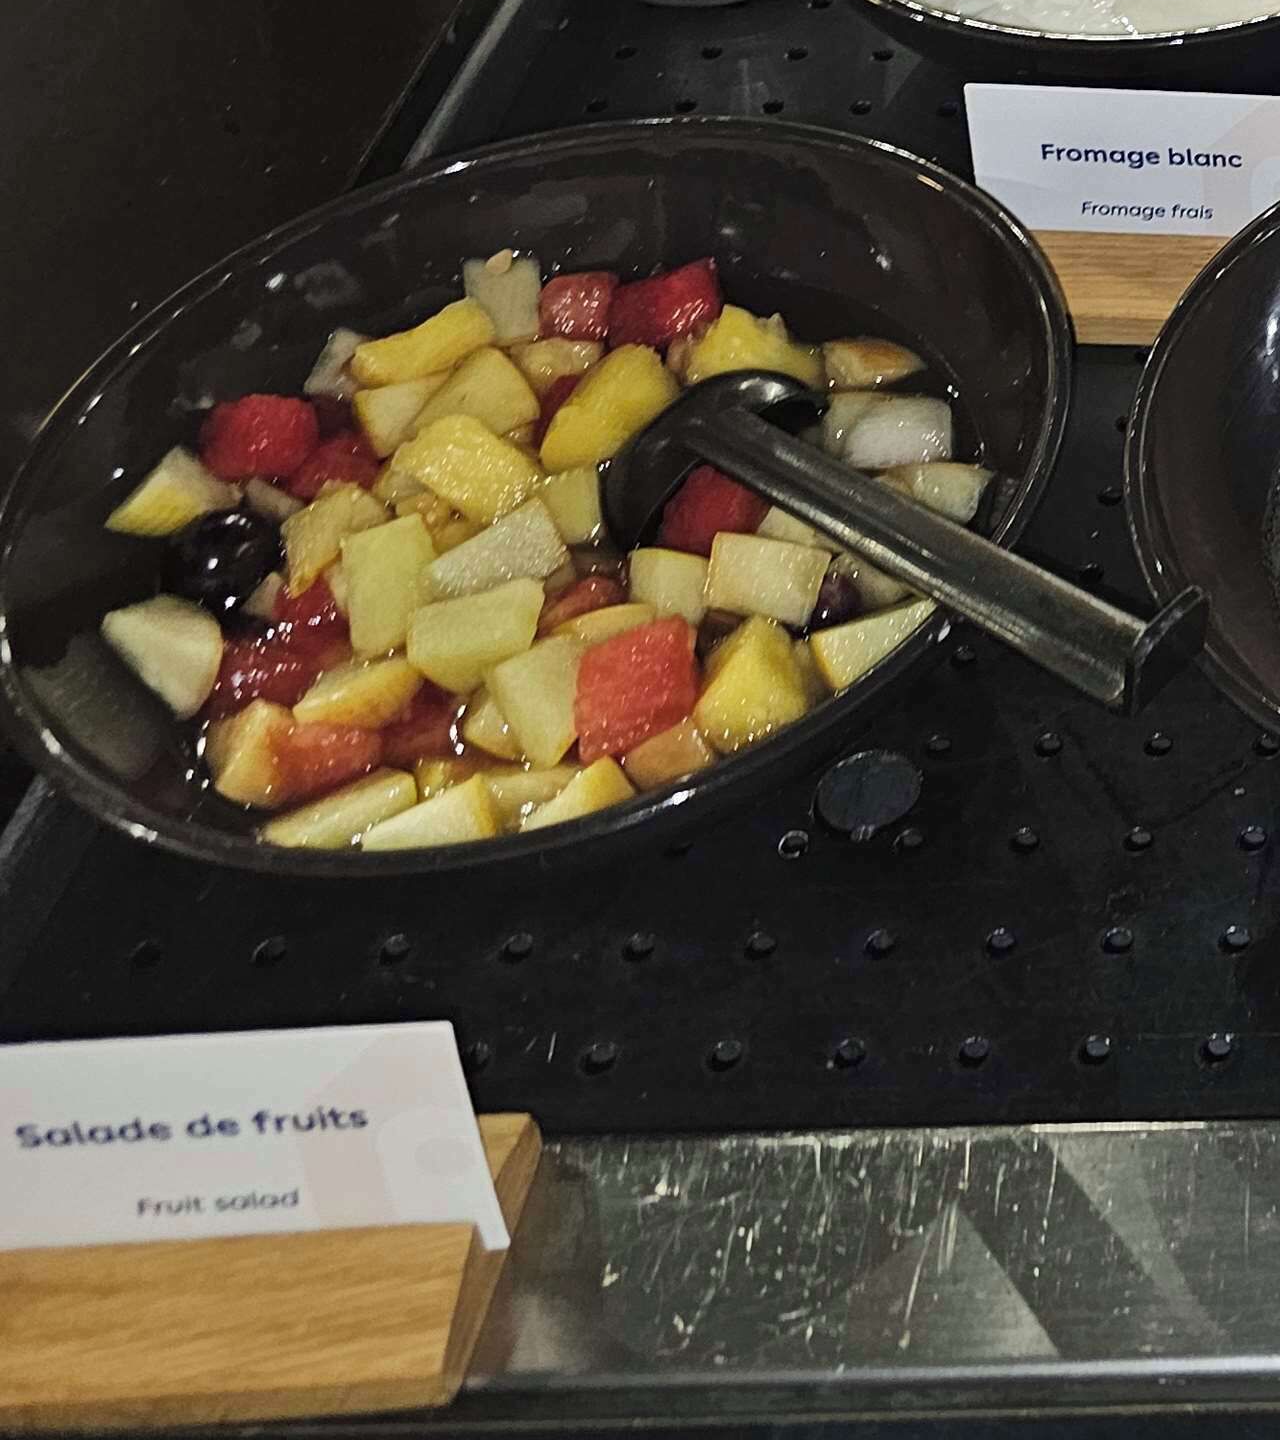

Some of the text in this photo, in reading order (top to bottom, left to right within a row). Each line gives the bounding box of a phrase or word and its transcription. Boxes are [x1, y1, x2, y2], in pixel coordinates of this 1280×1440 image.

[1040, 143, 1243, 170] Fromage blanc
[1080, 200, 1214, 221] Fromage frais
[15, 1105, 371, 1149] Salade de fruits
[136, 1188, 301, 1218] Fruit salad
